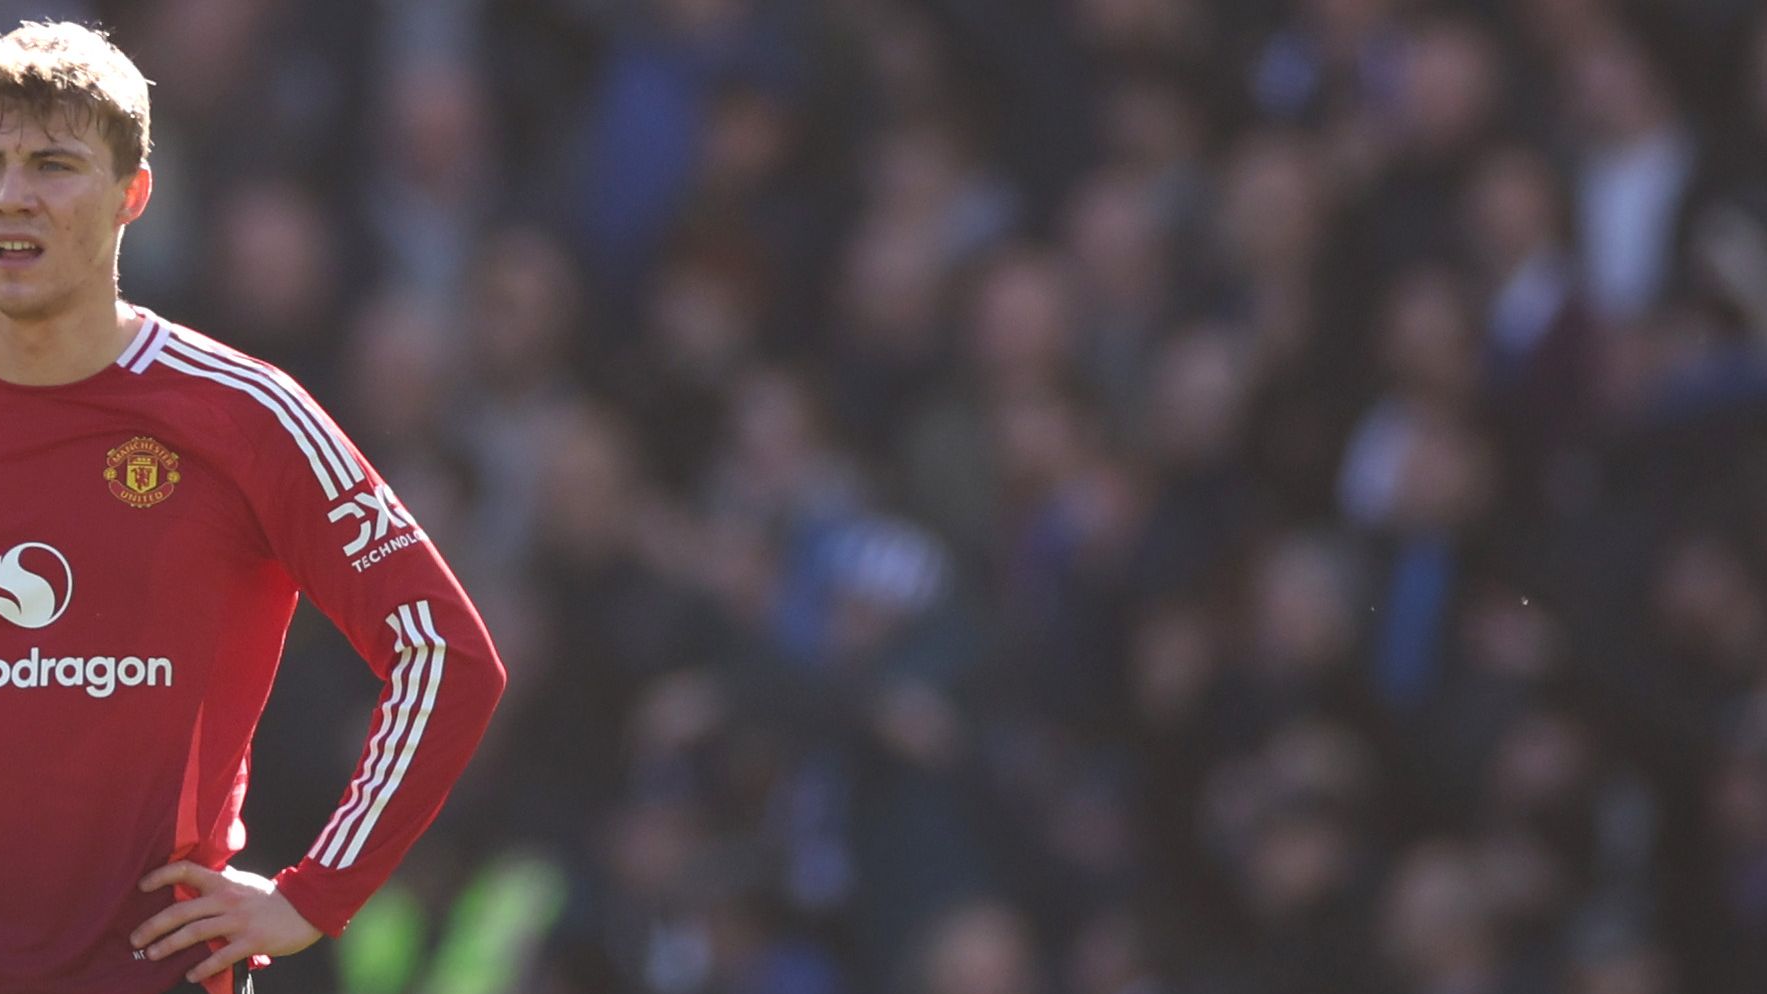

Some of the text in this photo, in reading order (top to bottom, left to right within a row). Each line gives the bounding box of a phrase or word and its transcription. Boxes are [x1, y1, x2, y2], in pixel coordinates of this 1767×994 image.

[111, 441, 174, 466] MANCHESTER
[120, 490, 164, 502] UNITED
[352, 528, 427, 573] TECHNOLO
